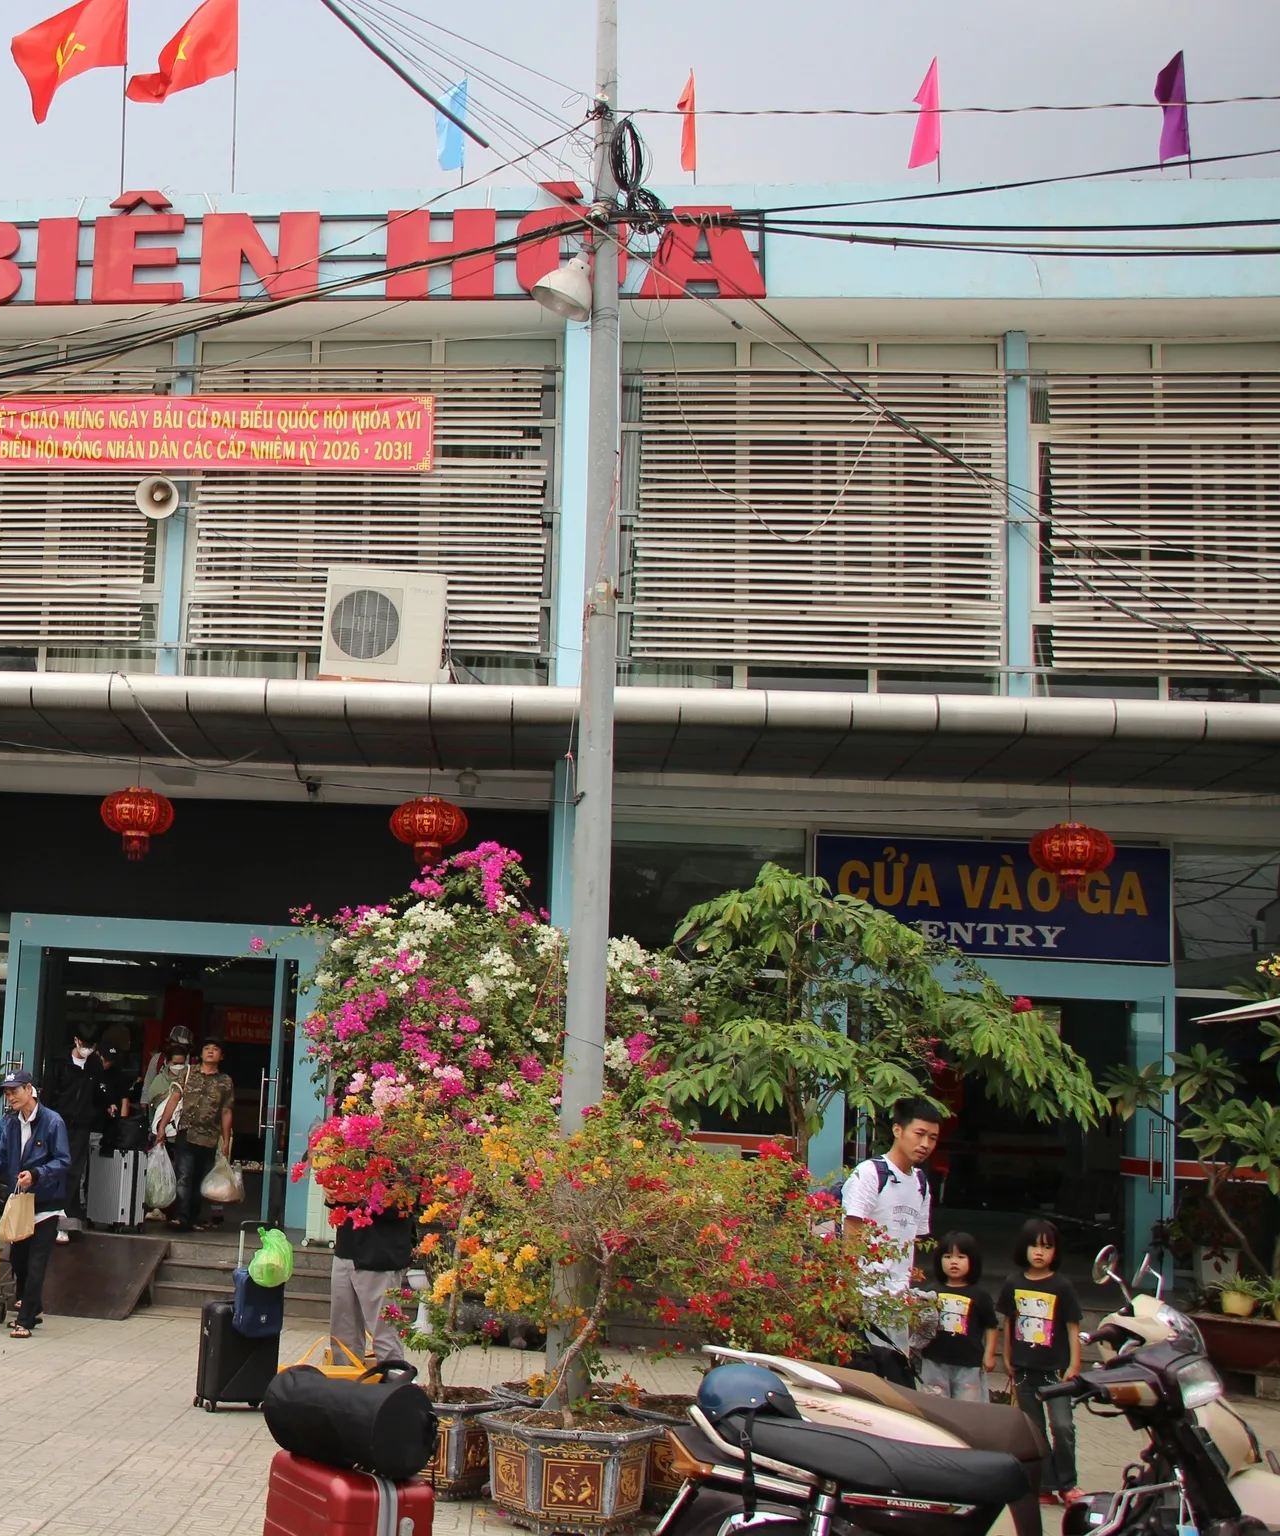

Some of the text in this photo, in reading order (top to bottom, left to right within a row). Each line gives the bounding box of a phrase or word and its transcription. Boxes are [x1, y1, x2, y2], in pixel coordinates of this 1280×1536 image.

[20, 405, 60, 430] CHÀO
[63, 405, 105, 430] MỪNG
[108, 404, 149, 430] NGÀY
[152, 401, 183, 429] BẦU
[187, 404, 209, 430] CỬ
[211, 409, 236, 434] ĐẠI
[240, 400, 273, 430] BIỂU
[277, 400, 320, 434] QUỐC
[323, 404, 348, 436] HỘI
[352, 404, 391, 436] KHÓA
[395, 410, 422, 430] XVI
[0, 430, 31, 459] BIỂU
[35, 434, 58, 463] HỘI
[62, 431, 103, 460] ĐỒNG
[106, 434, 146, 460] NHÂN
[148, 434, 180, 460] DÂN
[183, 433, 213, 460] CÁC
[216, 431, 246, 460] CẤP
[250, 434, 296, 464] NHIỆM
[299, 434, 319, 465] KỲ
[322, 440, 360, 460] 2026
[373, 440, 413, 461] 2031!
[837, 846, 1149, 916] CỬA VÀO GA
[920, 920, 1066, 948] ENTRY
[886, 1498, 931, 1510] FASHION
